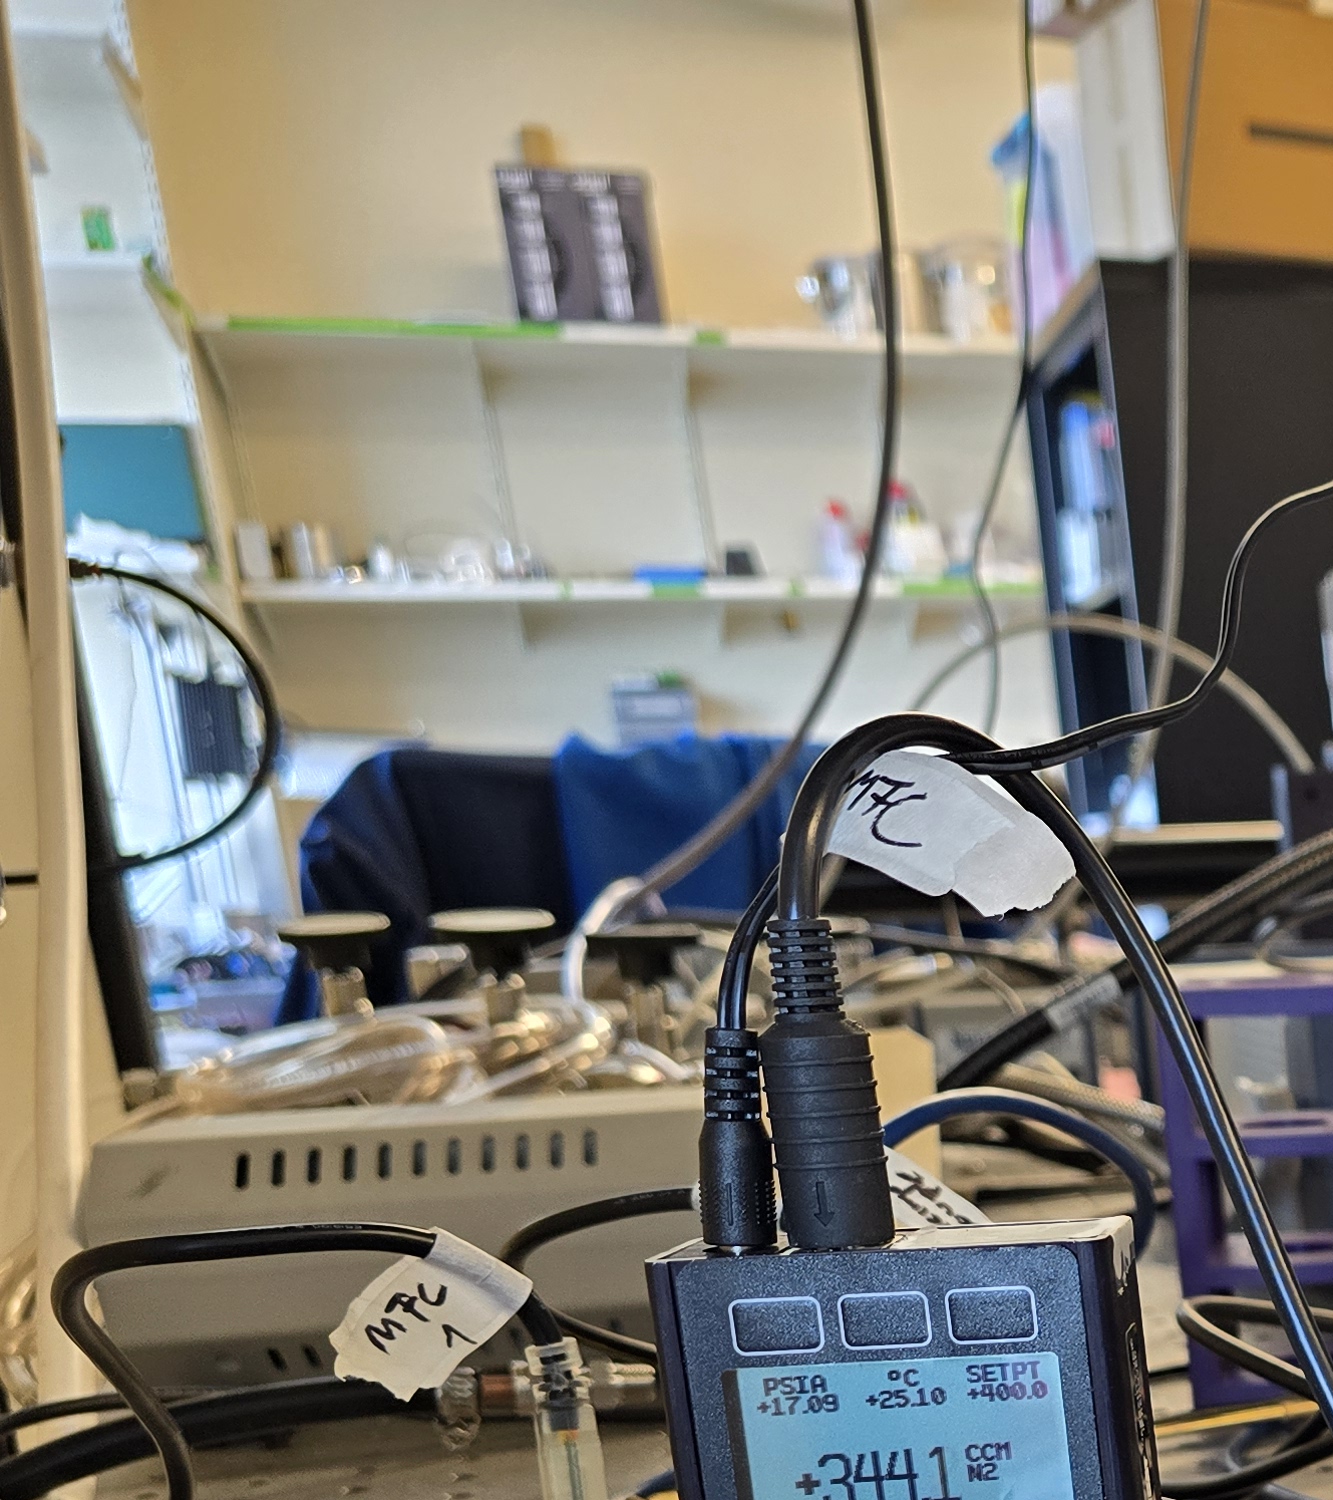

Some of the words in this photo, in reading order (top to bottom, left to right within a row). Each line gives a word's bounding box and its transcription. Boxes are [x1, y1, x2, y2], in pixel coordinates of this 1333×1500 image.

[763, 1374, 828, 1397] PSIA
[966, 1360, 1041, 1384] SETPT
[865, 1387, 947, 1410] +25.10
[966, 1380, 1049, 1403] +400.0
[964, 1441, 1014, 1463] CCM
[967, 1463, 1000, 1482] N2
